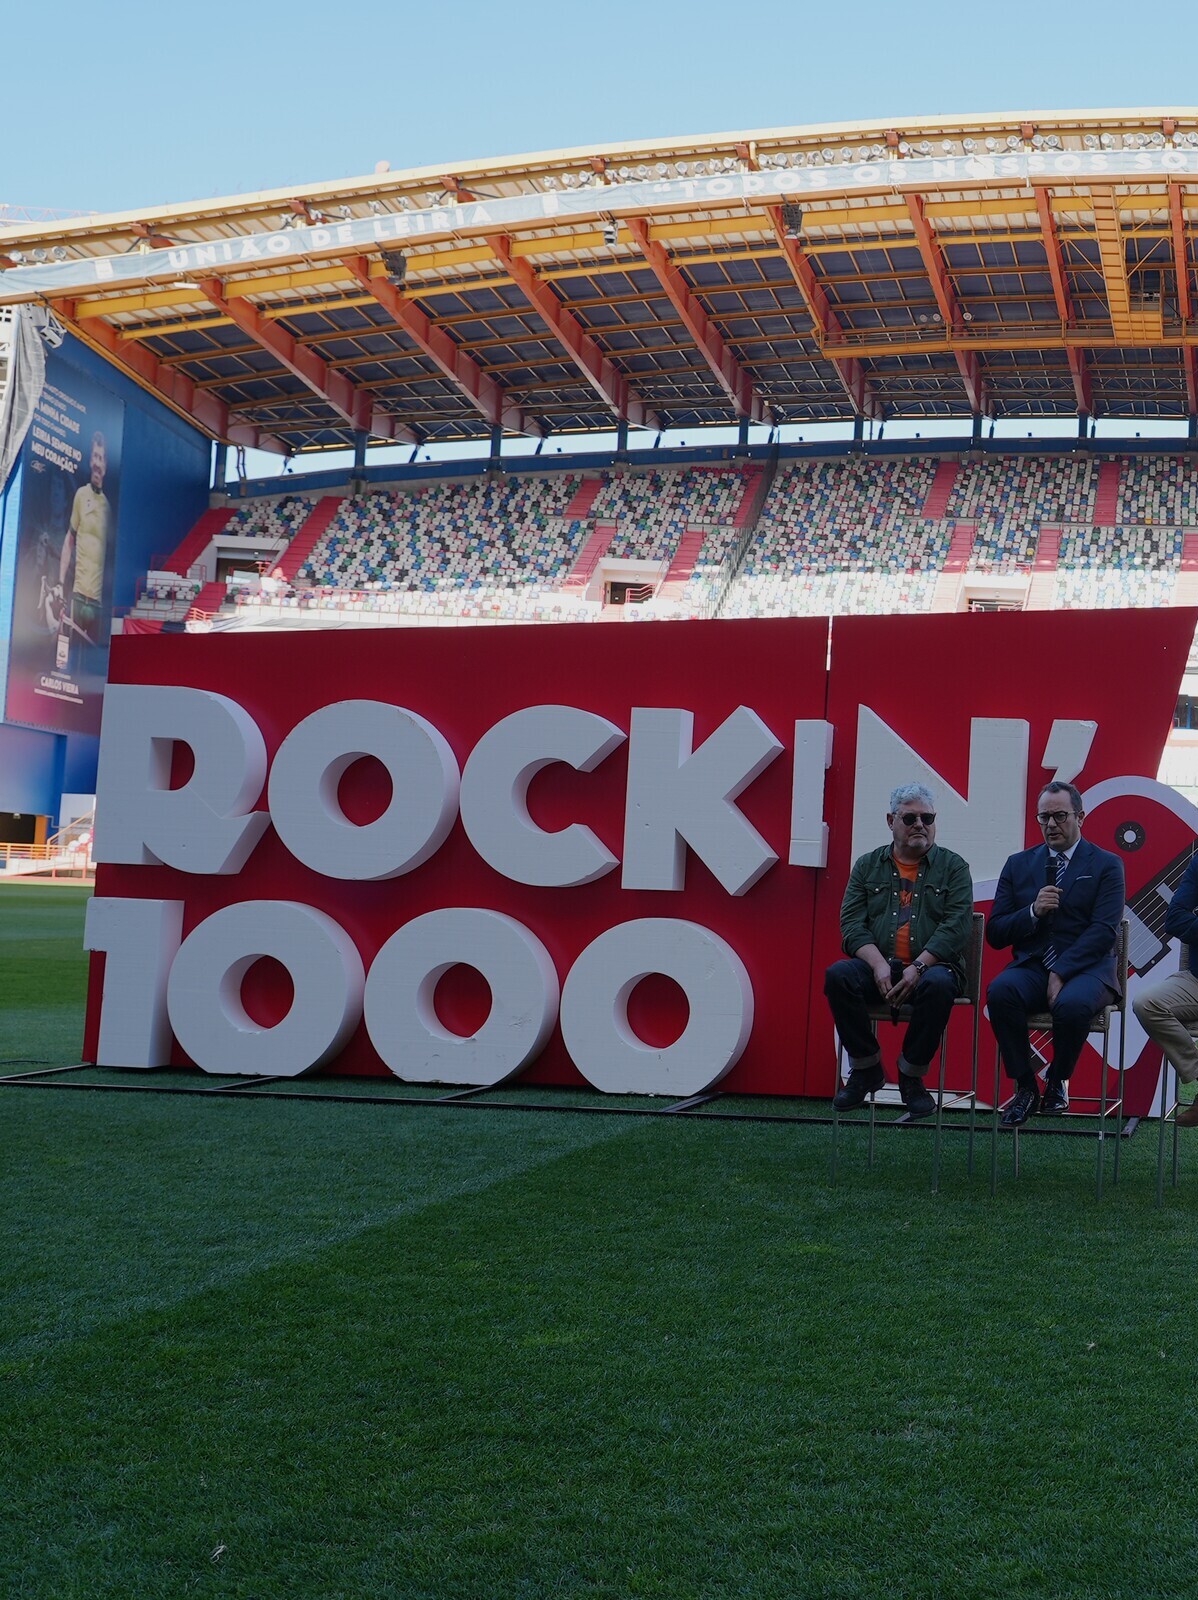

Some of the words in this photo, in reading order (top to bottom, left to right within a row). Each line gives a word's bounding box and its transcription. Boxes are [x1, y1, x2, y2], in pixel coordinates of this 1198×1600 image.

[168, 235, 292, 269] UNIÃO
[312, 226, 354, 248] DE
[374, 204, 492, 239] LEIRIA
[853, 162, 907, 183] OS
[91, 683, 1098, 896] ROCKIN'
[83, 896, 754, 1097] 1000
